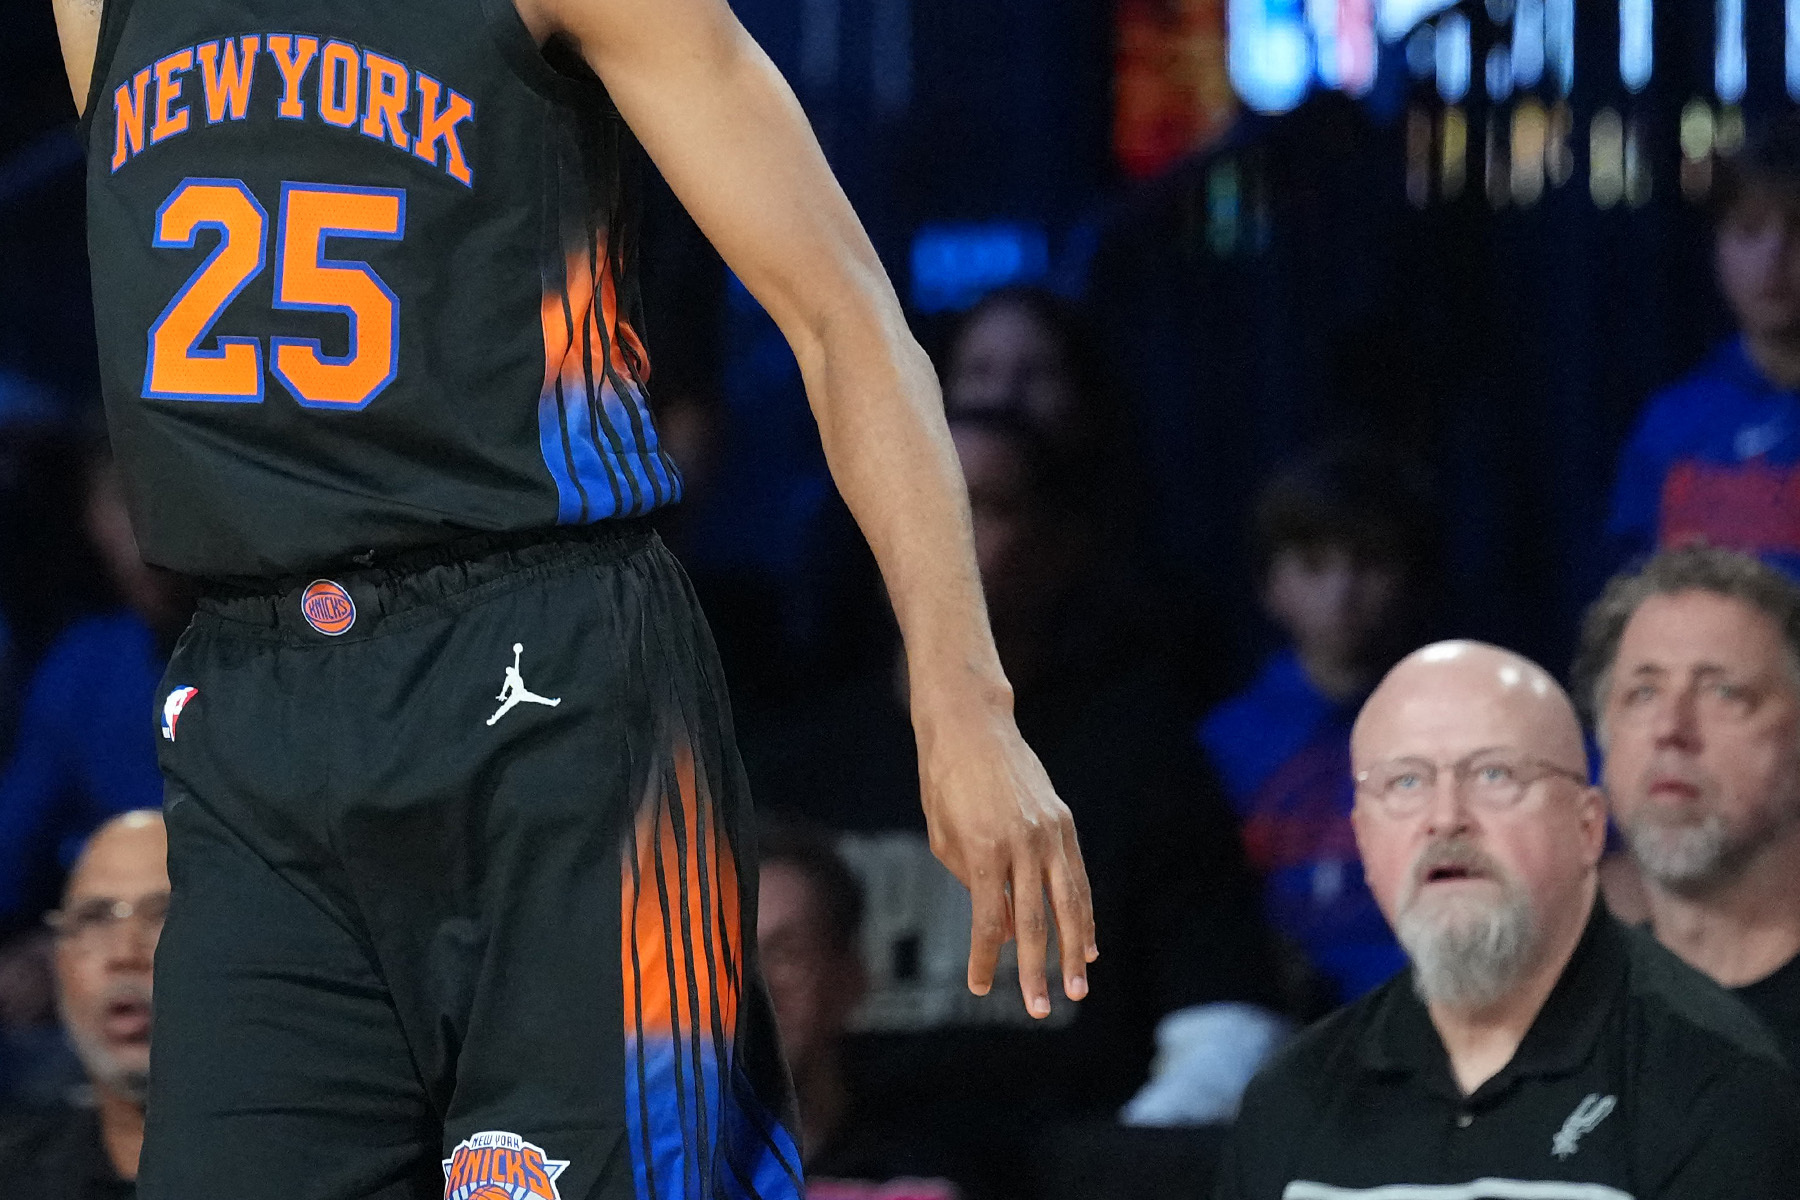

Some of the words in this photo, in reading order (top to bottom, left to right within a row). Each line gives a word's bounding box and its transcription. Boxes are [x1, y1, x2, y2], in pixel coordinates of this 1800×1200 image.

[110, 33, 261, 174] NEW
[266, 32, 475, 189] YORK
[140, 176, 407, 411] 25
[308, 596, 348, 620] KNICKS
[471, 1135, 494, 1148] NEW
[495, 1134, 520, 1149] YORK
[445, 1146, 555, 1200] KNICKS
